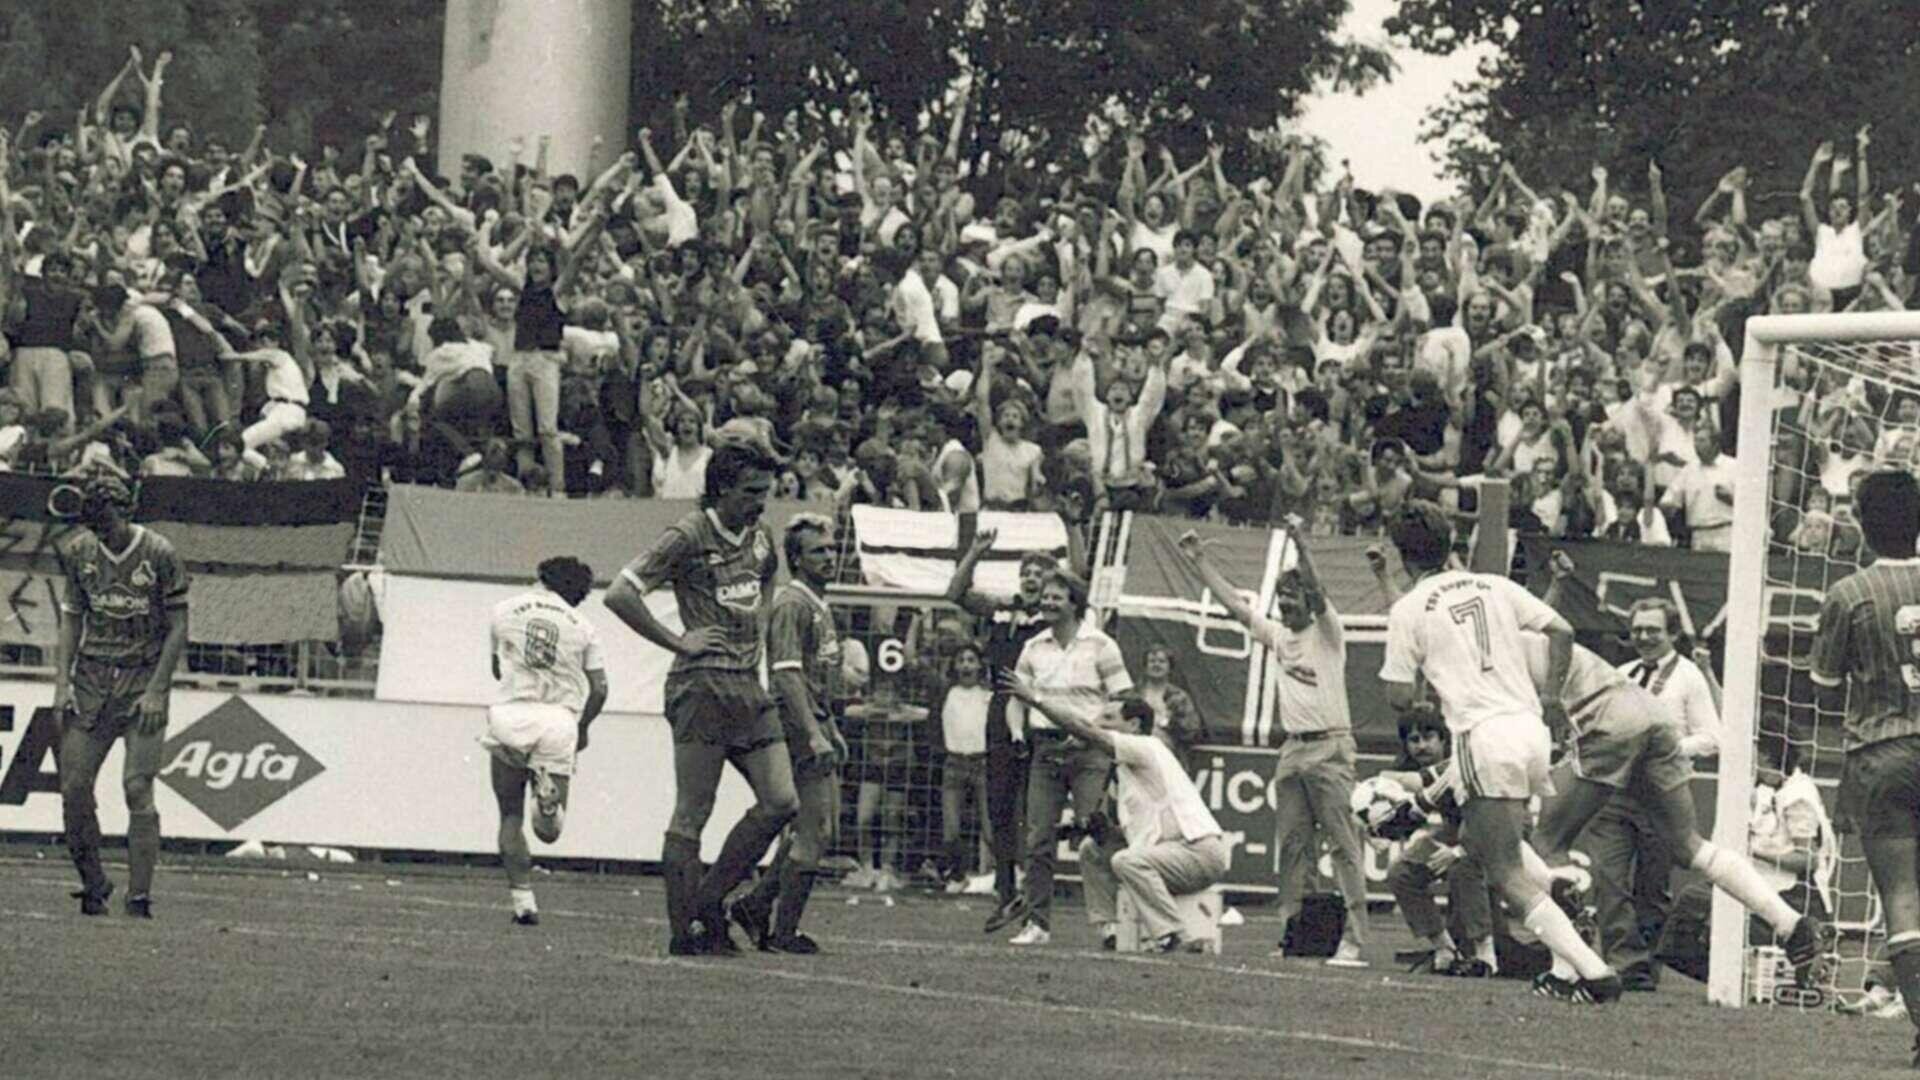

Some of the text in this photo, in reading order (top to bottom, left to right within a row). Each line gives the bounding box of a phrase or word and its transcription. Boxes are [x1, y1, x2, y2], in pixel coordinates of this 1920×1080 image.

[524, 617, 560, 670] 8
[877, 637, 905, 673] 6
[1448, 595, 1495, 673] 7
[159, 740, 299, 790] Agfa
